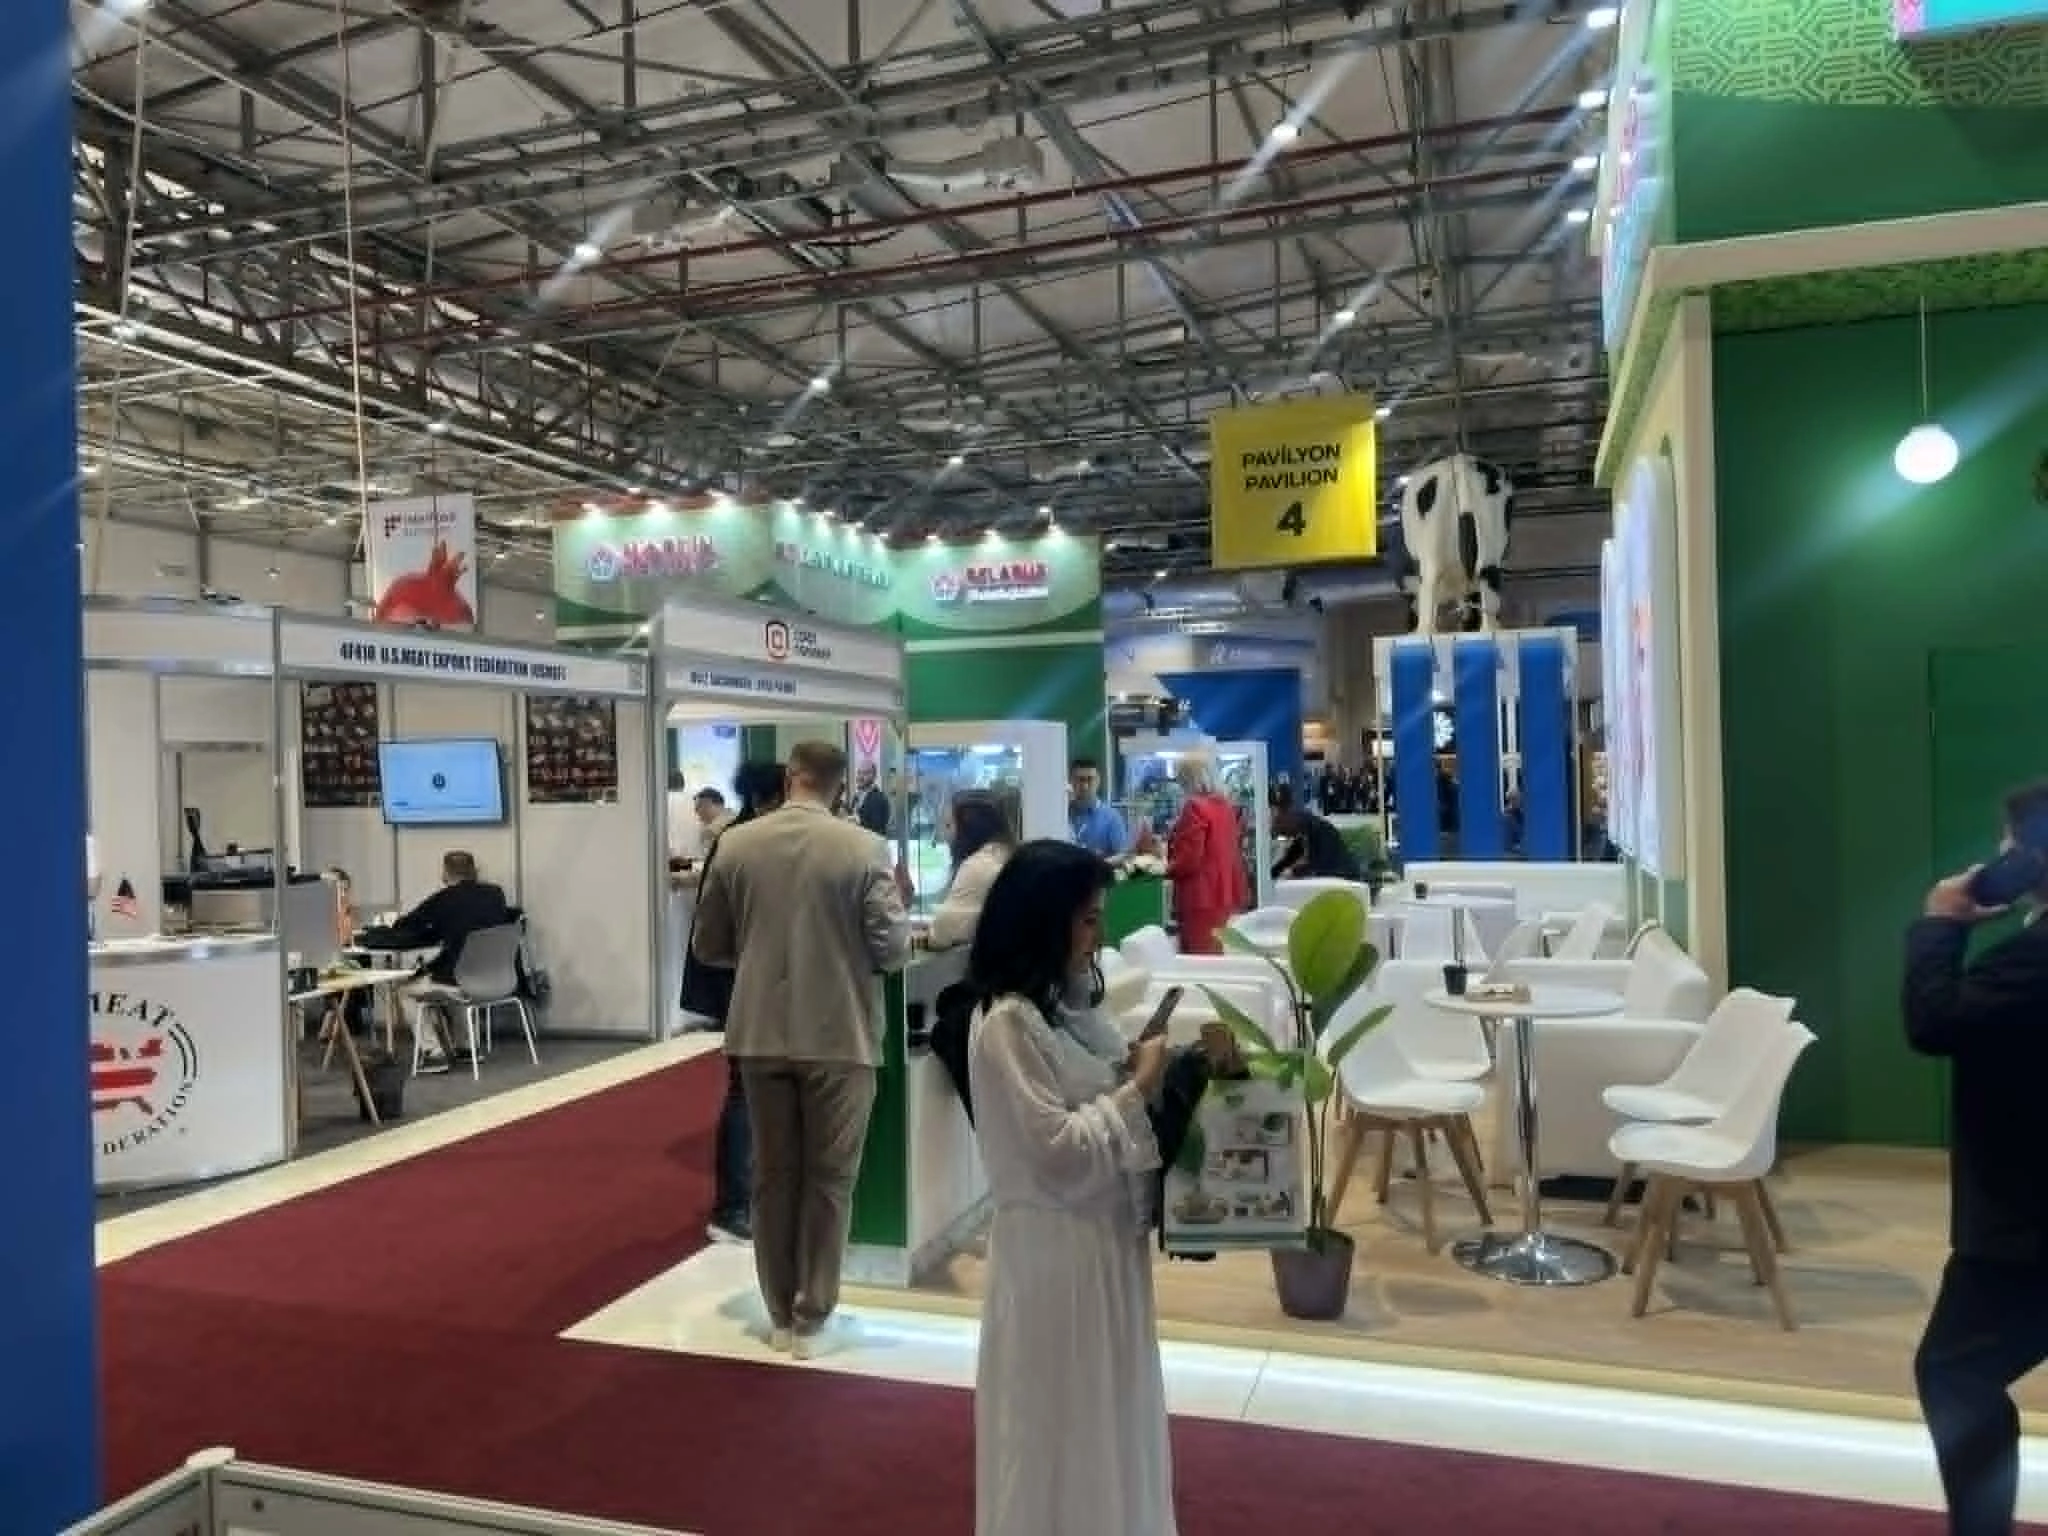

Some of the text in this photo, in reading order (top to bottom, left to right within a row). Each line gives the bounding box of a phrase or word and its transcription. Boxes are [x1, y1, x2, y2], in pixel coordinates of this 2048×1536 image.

[1240, 442, 1342, 469] PAVİLYON
[1243, 467, 1339, 492] PAVILION
[1276, 500, 1306, 537] 4
[102, 1081, 193, 1155] DERATION
